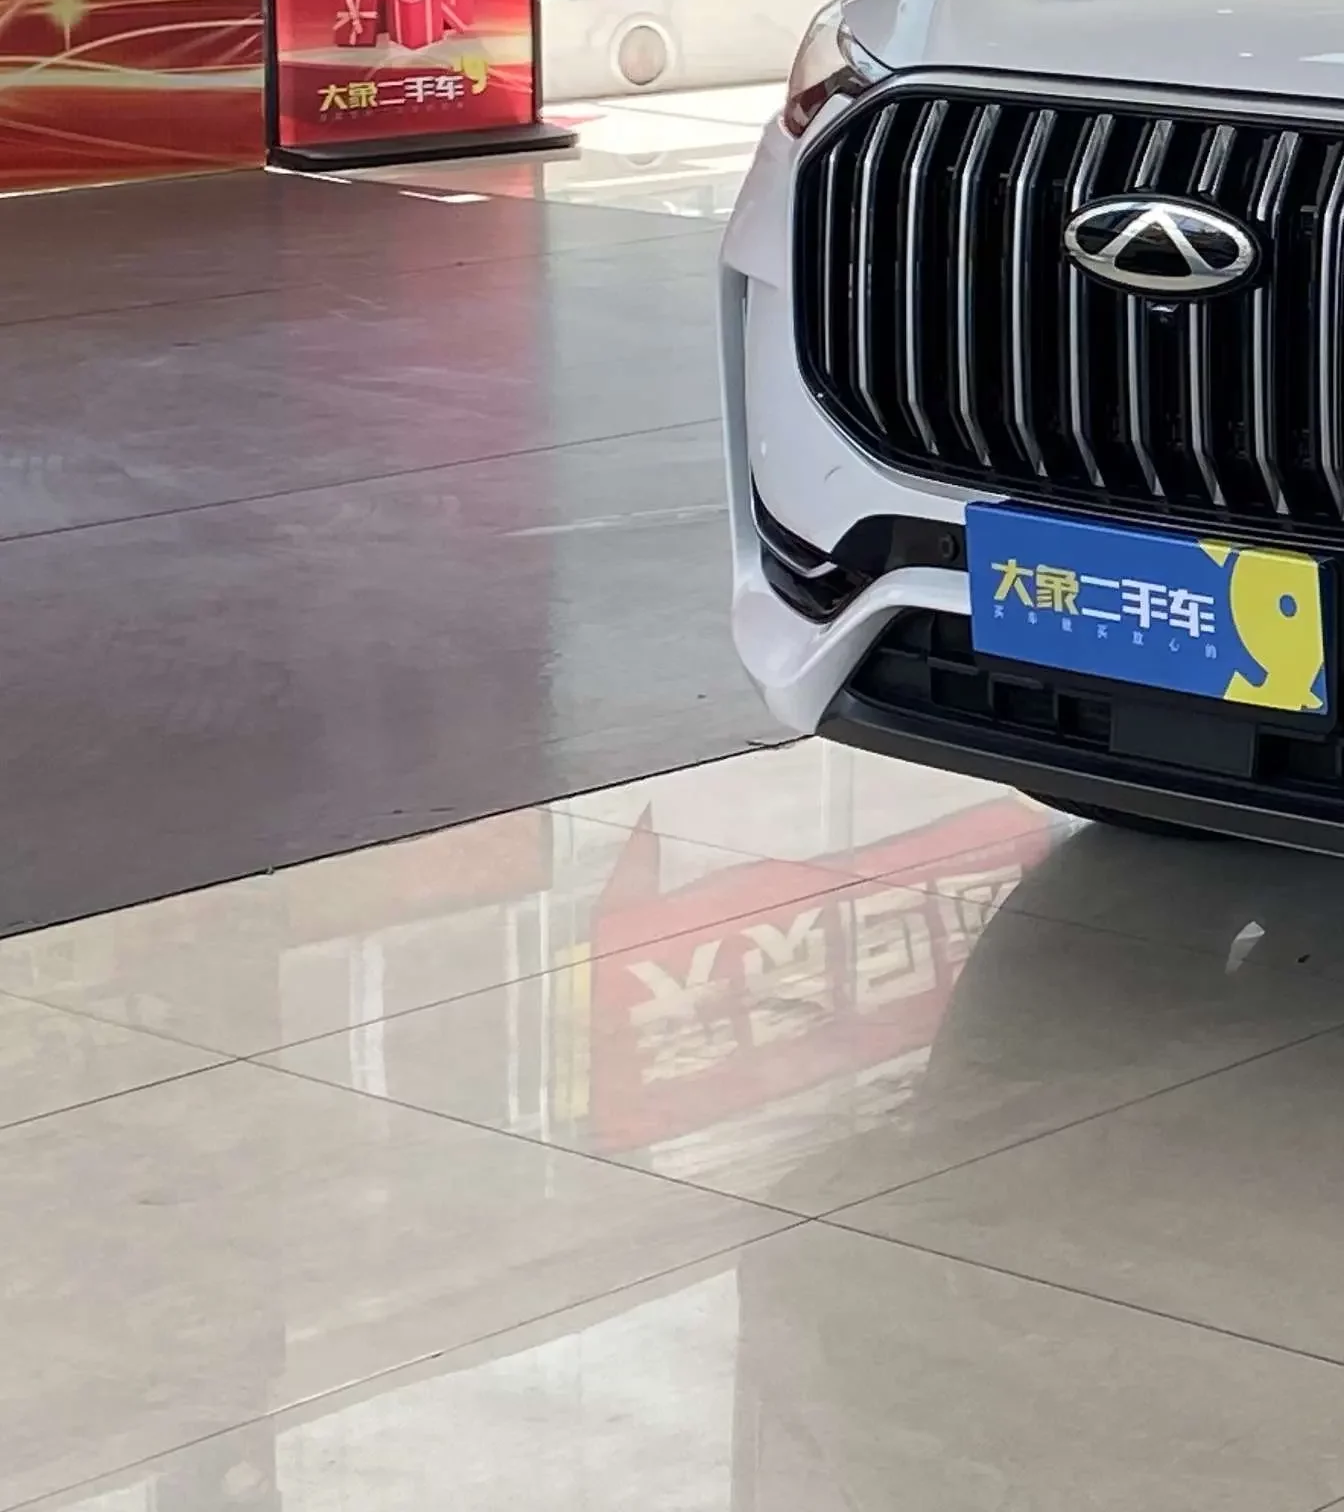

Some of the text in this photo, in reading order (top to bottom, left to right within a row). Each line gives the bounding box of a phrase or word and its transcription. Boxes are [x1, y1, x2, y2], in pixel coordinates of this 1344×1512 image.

[317, 76, 464, 112] 大象二手车
[991, 559, 1216, 638] 大象二手车
